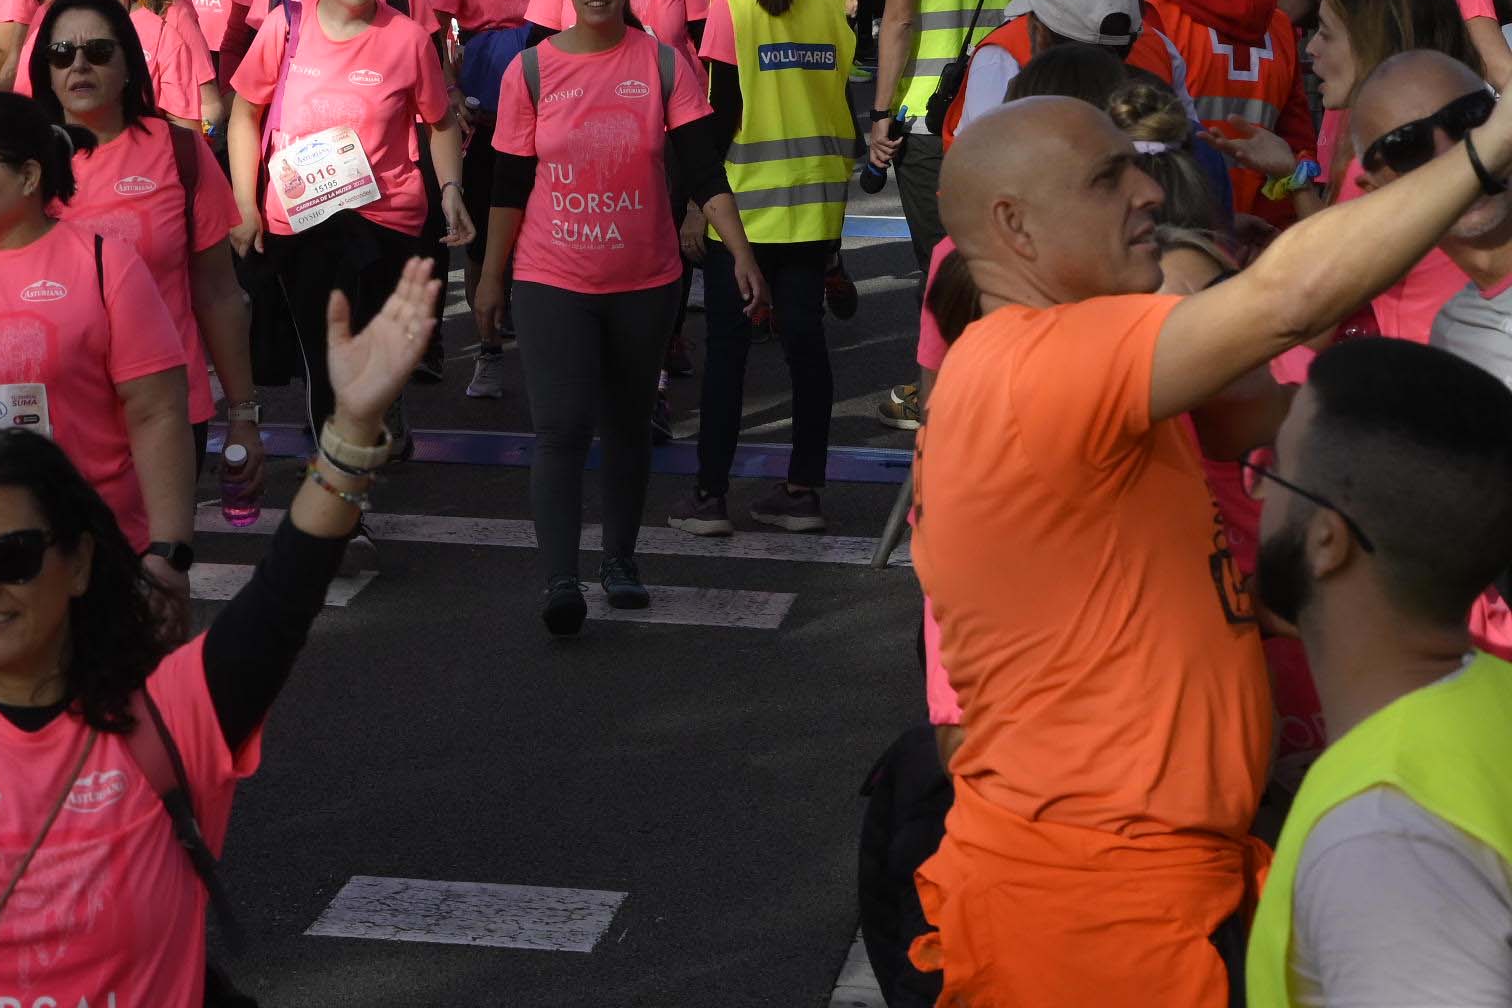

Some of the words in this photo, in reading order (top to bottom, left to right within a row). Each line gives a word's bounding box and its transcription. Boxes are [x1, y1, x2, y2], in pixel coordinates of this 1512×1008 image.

[545, 88, 584, 103] OYSHO
[306, 164, 336, 184] 016
[548, 163, 573, 184] TU
[314, 180, 338, 194] 15195
[295, 199, 320, 212] CARRERA
[552, 190, 643, 214] DORSAL
[299, 208, 325, 225] OYSHO
[552, 219, 622, 242] SUMA
[12, 400, 38, 408] SUMA
